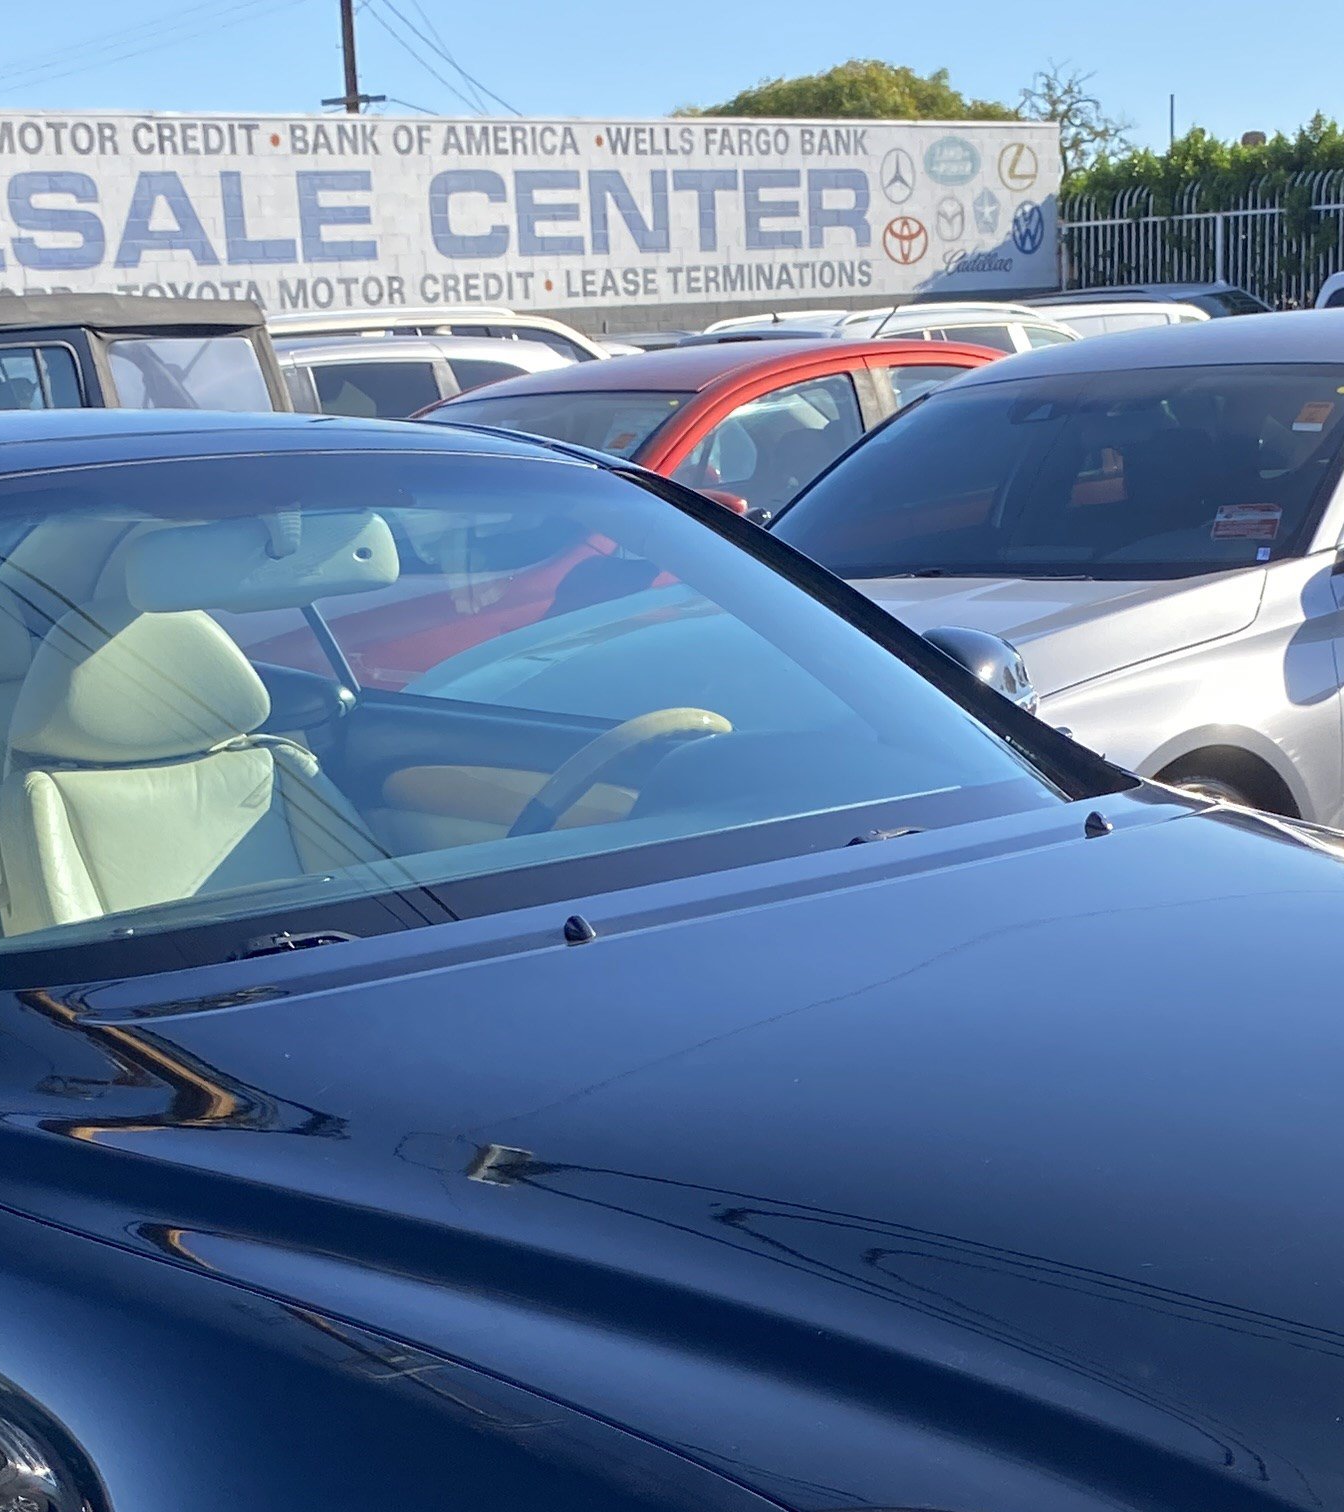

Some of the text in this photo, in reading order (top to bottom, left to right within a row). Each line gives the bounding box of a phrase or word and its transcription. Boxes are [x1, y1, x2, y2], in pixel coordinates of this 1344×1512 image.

[133, 121, 260, 156] CREDIT
[289, 123, 580, 156] BANK OF AMERICA
[606, 127, 870, 157] WELLS FARGO BANK
[429, 168, 871, 260] CENTER
[280, 275, 406, 311] MOTOR
[420, 271, 535, 303] CREDIT
[566, 260, 872, 298] LEASE TERMINATIONS
